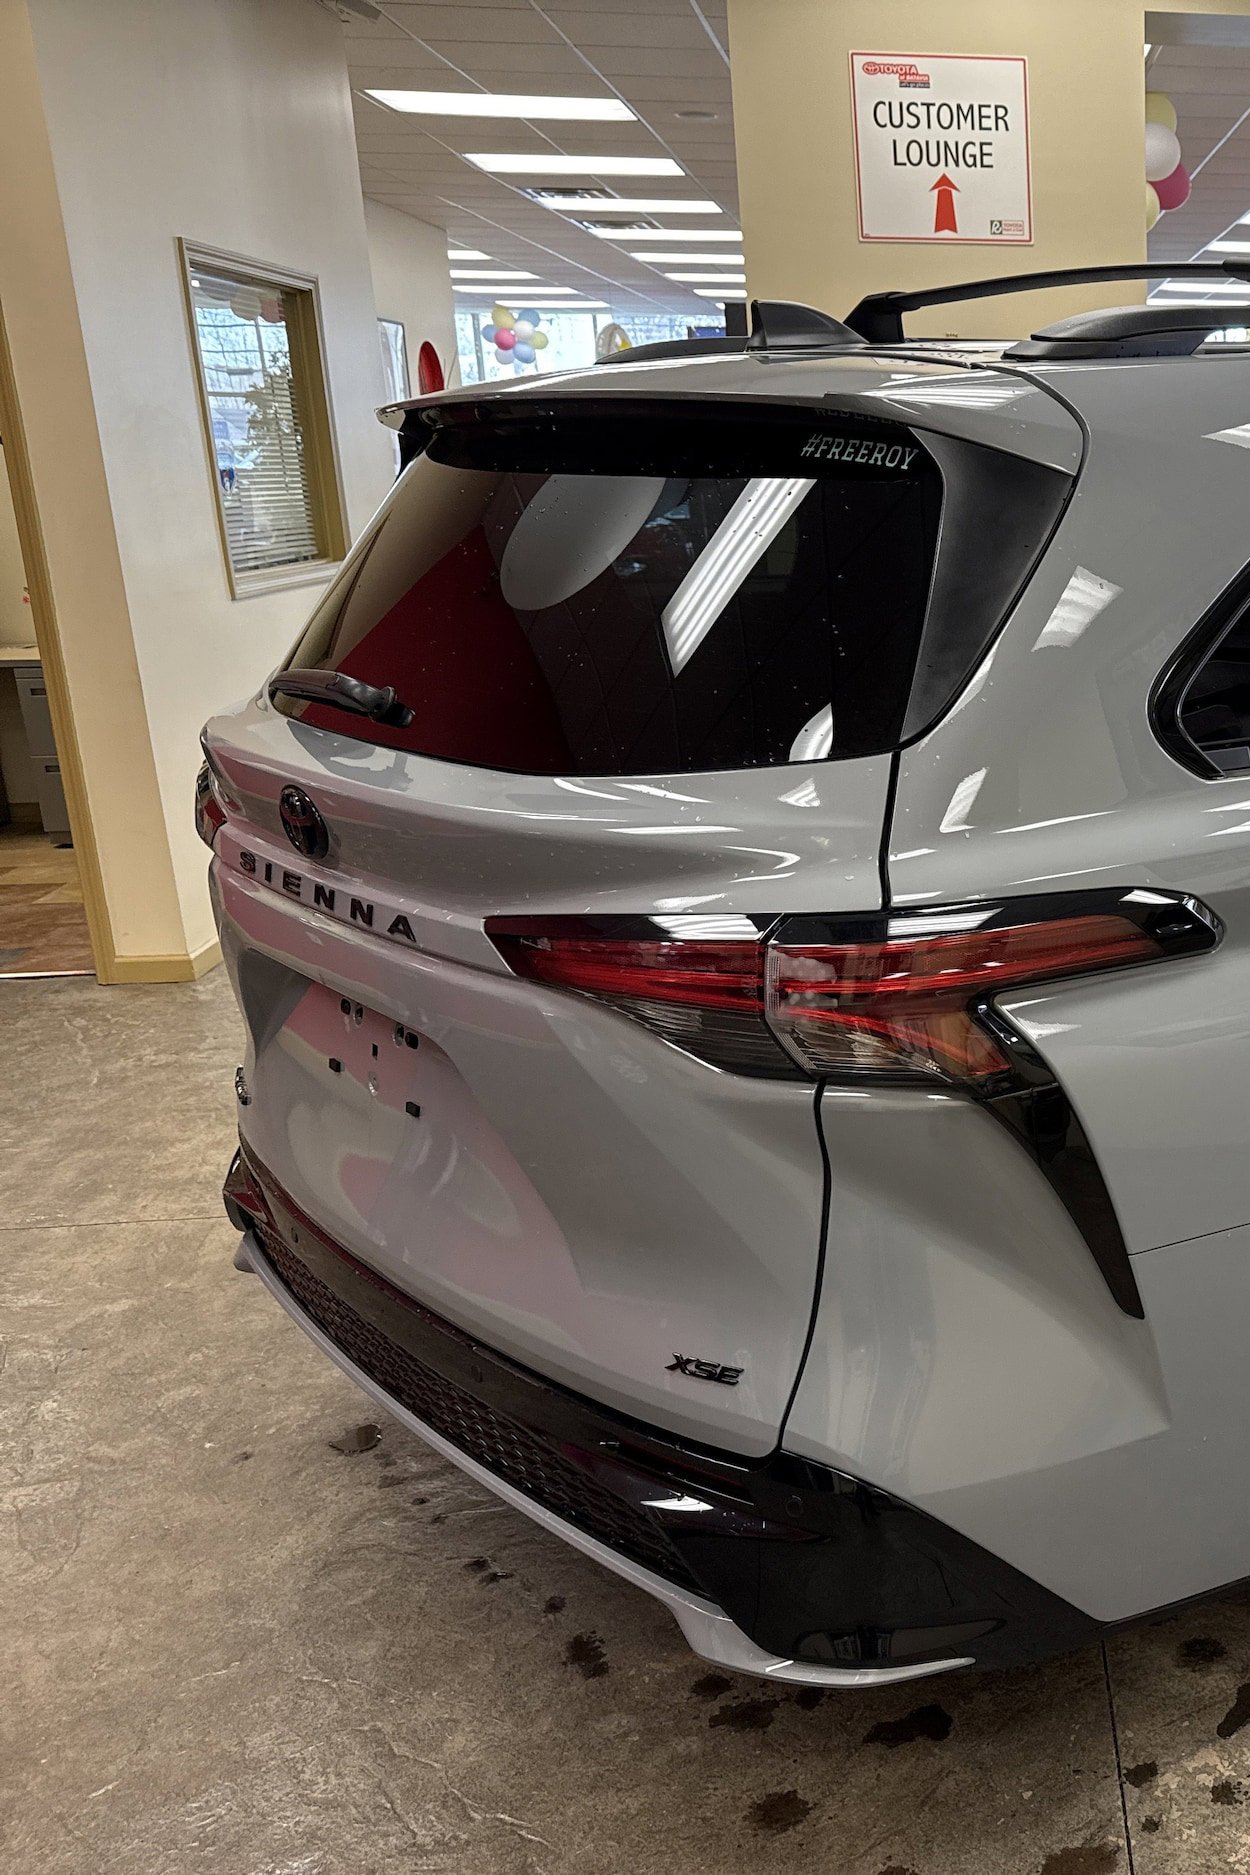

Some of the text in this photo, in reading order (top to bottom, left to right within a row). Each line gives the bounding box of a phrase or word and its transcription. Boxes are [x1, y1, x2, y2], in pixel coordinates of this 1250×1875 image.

[878, 64, 917, 74] TOYOTA
[873, 101, 1009, 131] CUSTOMER
[892, 139, 994, 168] LOUNGE
[800, 434, 919, 470] #FREEROY
[240, 851, 417, 942] SIENNA
[664, 1352, 744, 1386] XSE
